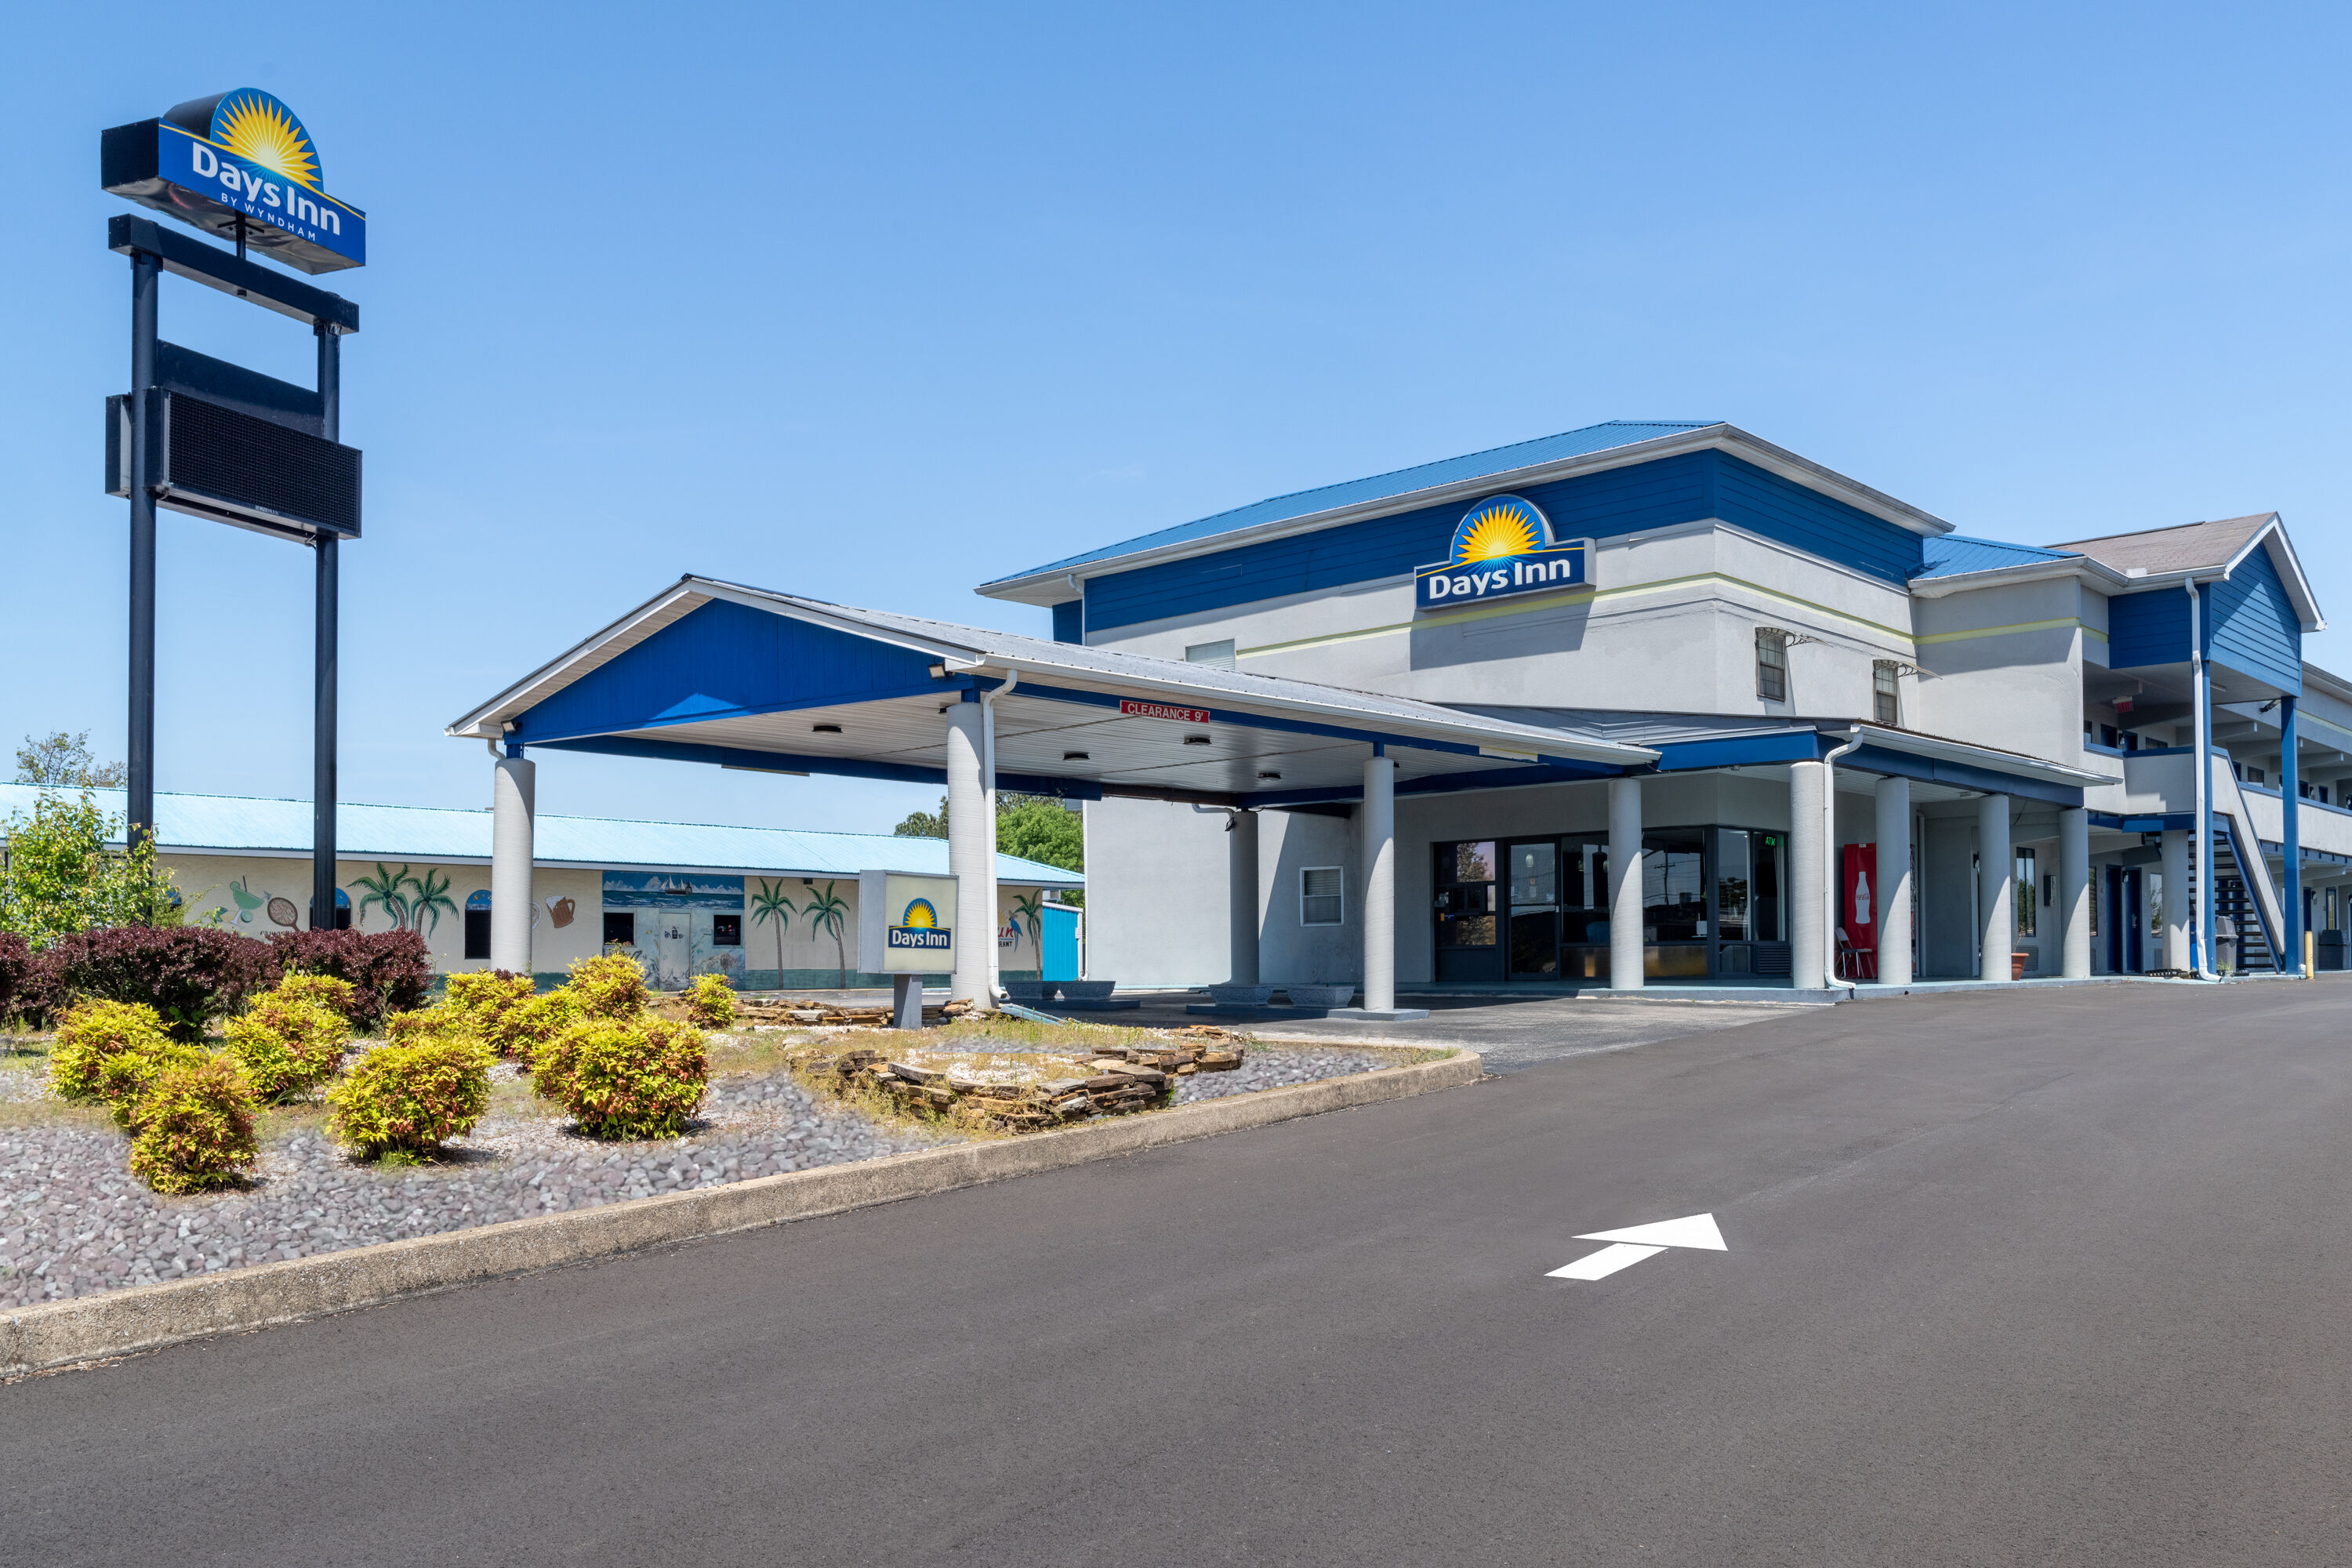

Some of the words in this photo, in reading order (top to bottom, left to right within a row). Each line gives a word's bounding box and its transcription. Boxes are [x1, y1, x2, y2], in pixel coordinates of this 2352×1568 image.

[193, 141, 281, 208] Days
[287, 186, 340, 235] Inn
[221, 193, 237, 207] BY
[245, 203, 316, 241] WYNDHAM
[1428, 569, 1508, 600] Days
[1514, 558, 1570, 586] Inn
[1127, 702, 1191, 720] CLEARANCE
[892, 929, 924, 947] Days
[926, 931, 947, 946] Inn
